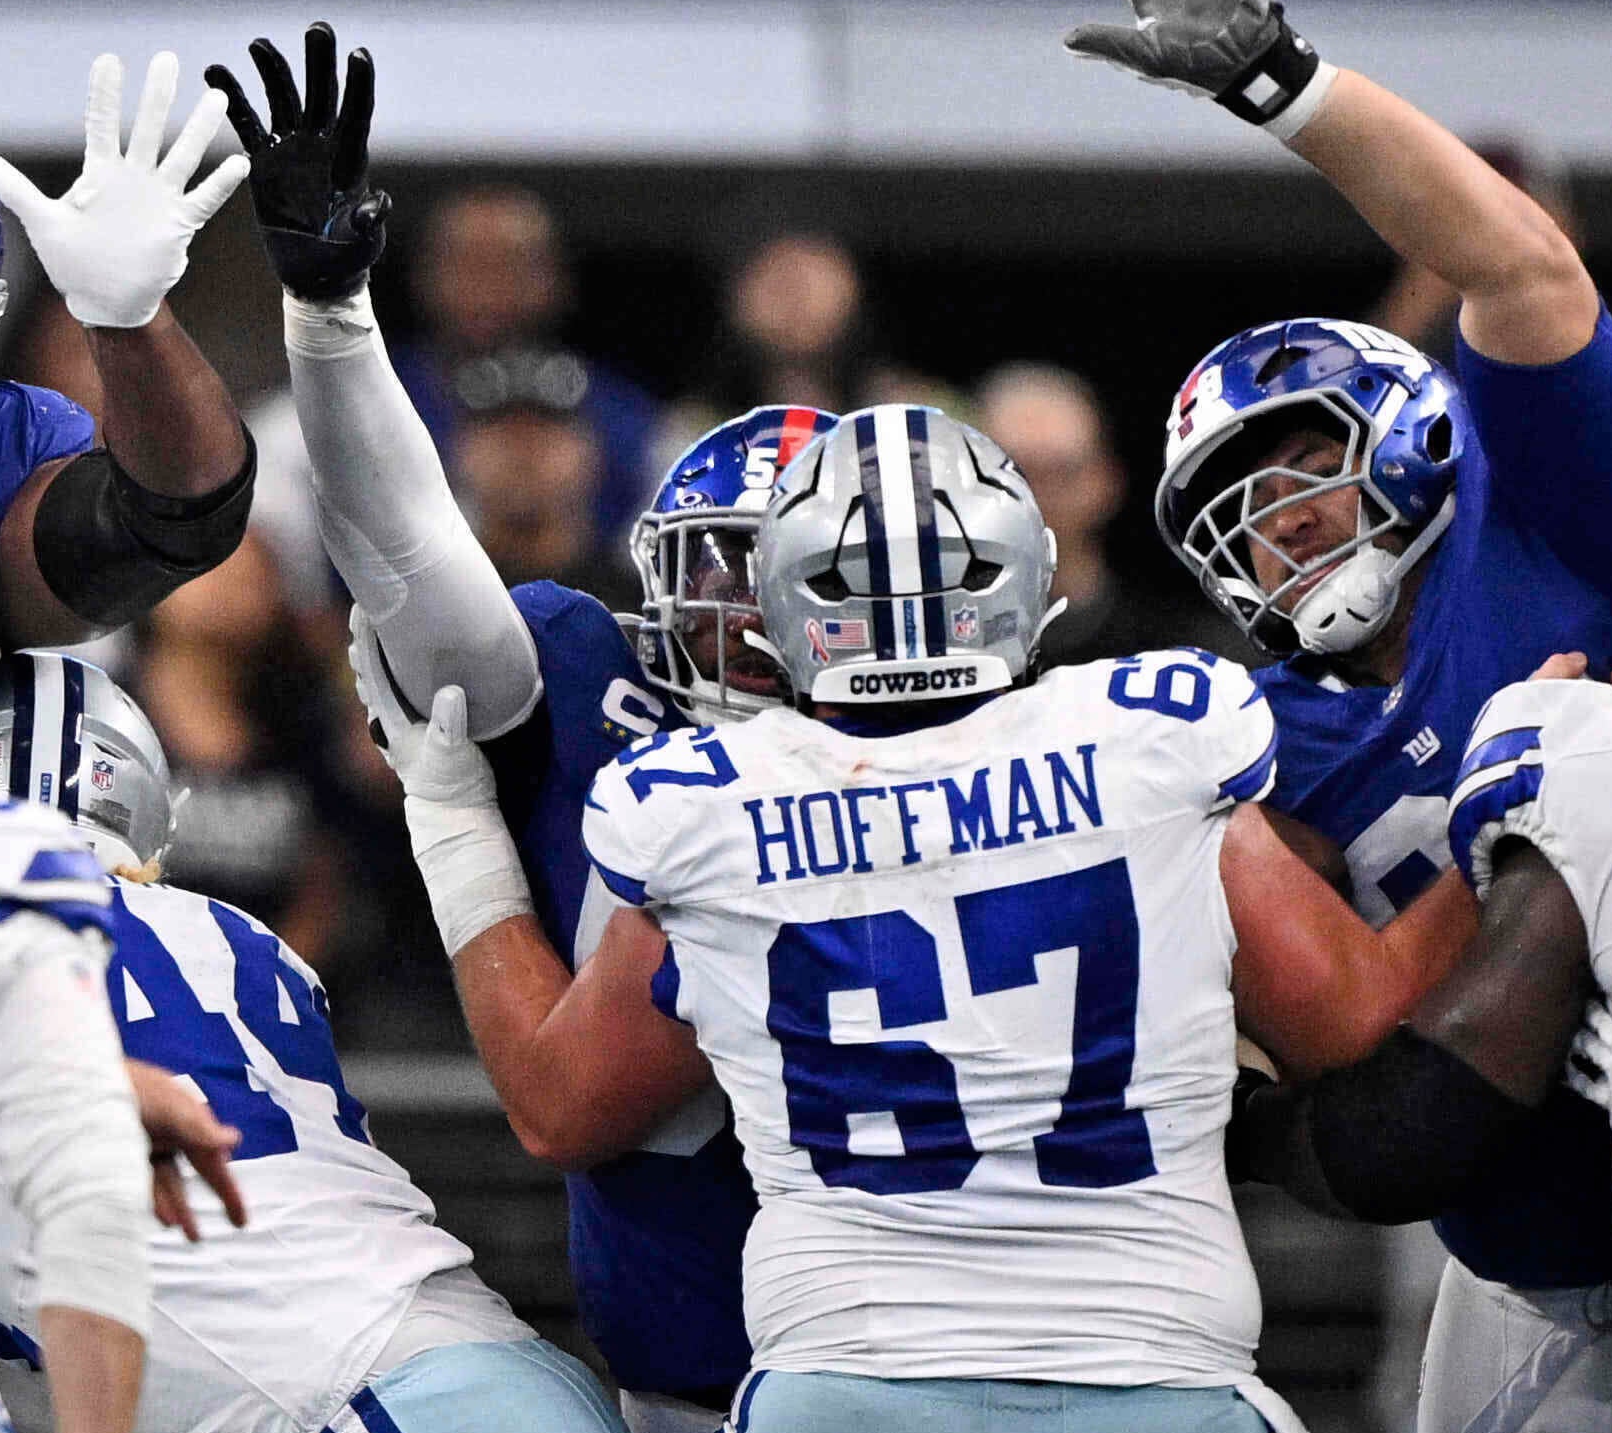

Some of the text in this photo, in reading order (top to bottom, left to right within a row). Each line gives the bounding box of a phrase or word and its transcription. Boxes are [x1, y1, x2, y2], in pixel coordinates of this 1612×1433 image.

[601, 677, 665, 737] C
[849, 666, 978, 695] COWBOYS
[743, 743, 1106, 885] HOFFMAN
[766, 856, 1160, 1196] 67
